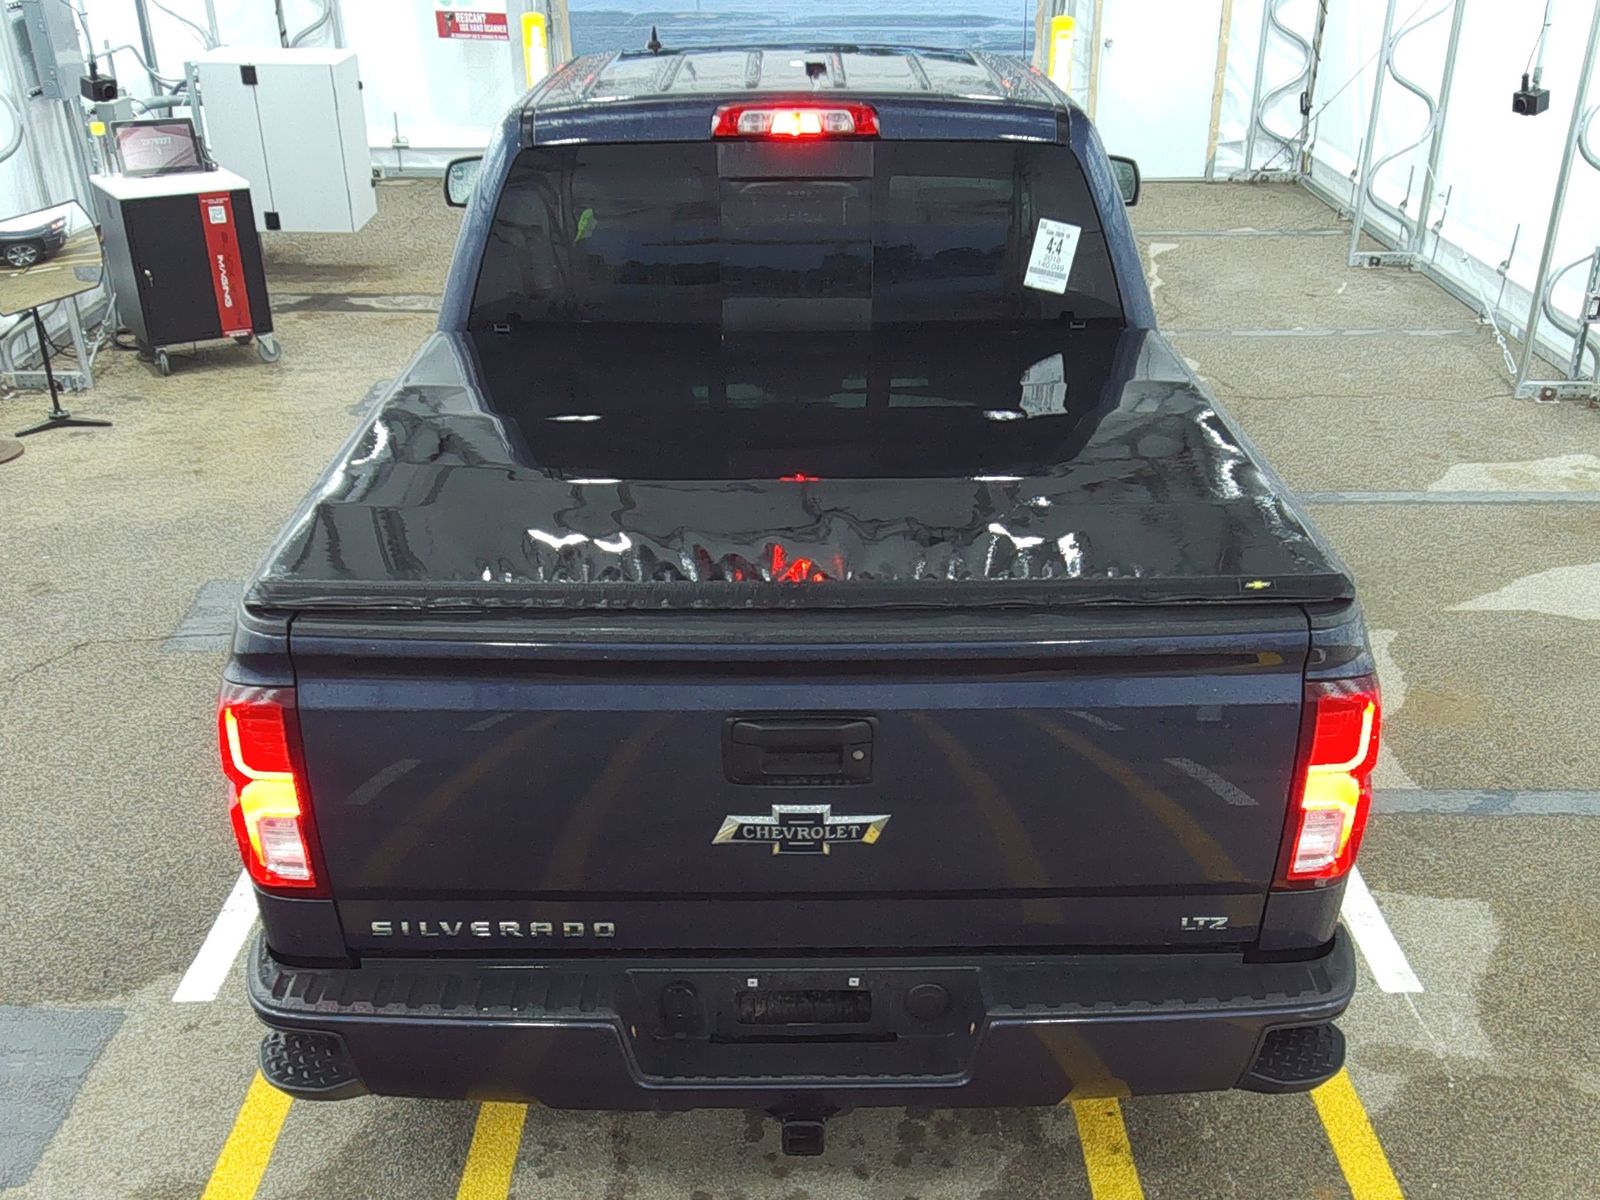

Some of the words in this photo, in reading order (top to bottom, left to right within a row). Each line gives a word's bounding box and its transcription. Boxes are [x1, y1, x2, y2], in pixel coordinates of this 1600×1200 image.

[455, 12, 486, 24] RESCAN?
[459, 23, 470, 32] USE
[469, 24, 483, 32] HAND
[484, 24, 507, 33] SCANNER
[216, 254, 233, 308] IMAGING
[742, 825, 861, 839] CHEVROLET
[371, 921, 616, 937] SILVERADO
[1181, 917, 1228, 930] LTZ
